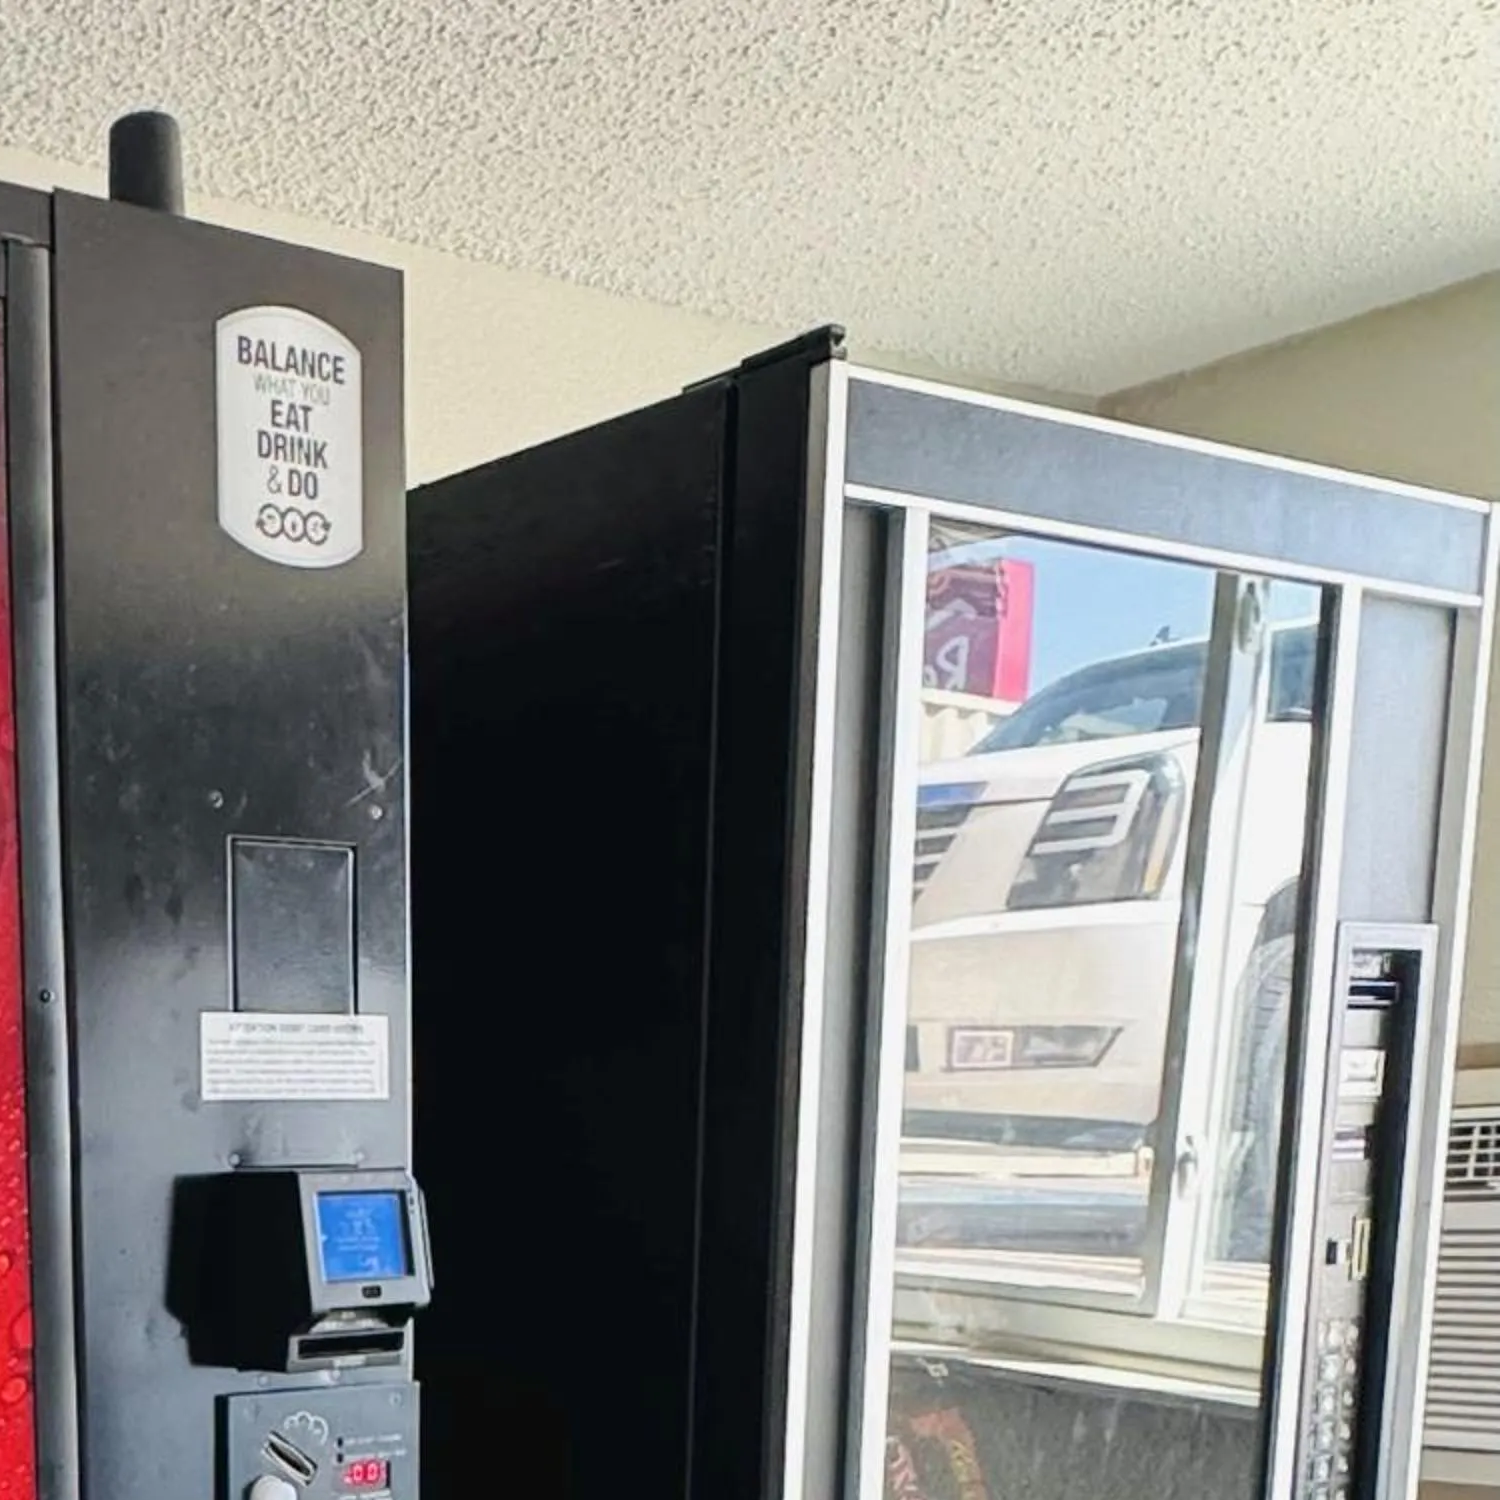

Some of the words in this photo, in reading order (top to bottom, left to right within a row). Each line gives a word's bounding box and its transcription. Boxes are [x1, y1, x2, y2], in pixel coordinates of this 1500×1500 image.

[237, 335, 345, 384] BALANCE
[254, 374, 297, 398] WHAT
[302, 381, 331, 405] YOU
[271, 399, 313, 433] EAT
[257, 430, 328, 469] DRINK
[267, 465, 282, 494] &
[287, 468, 319, 500] DO
